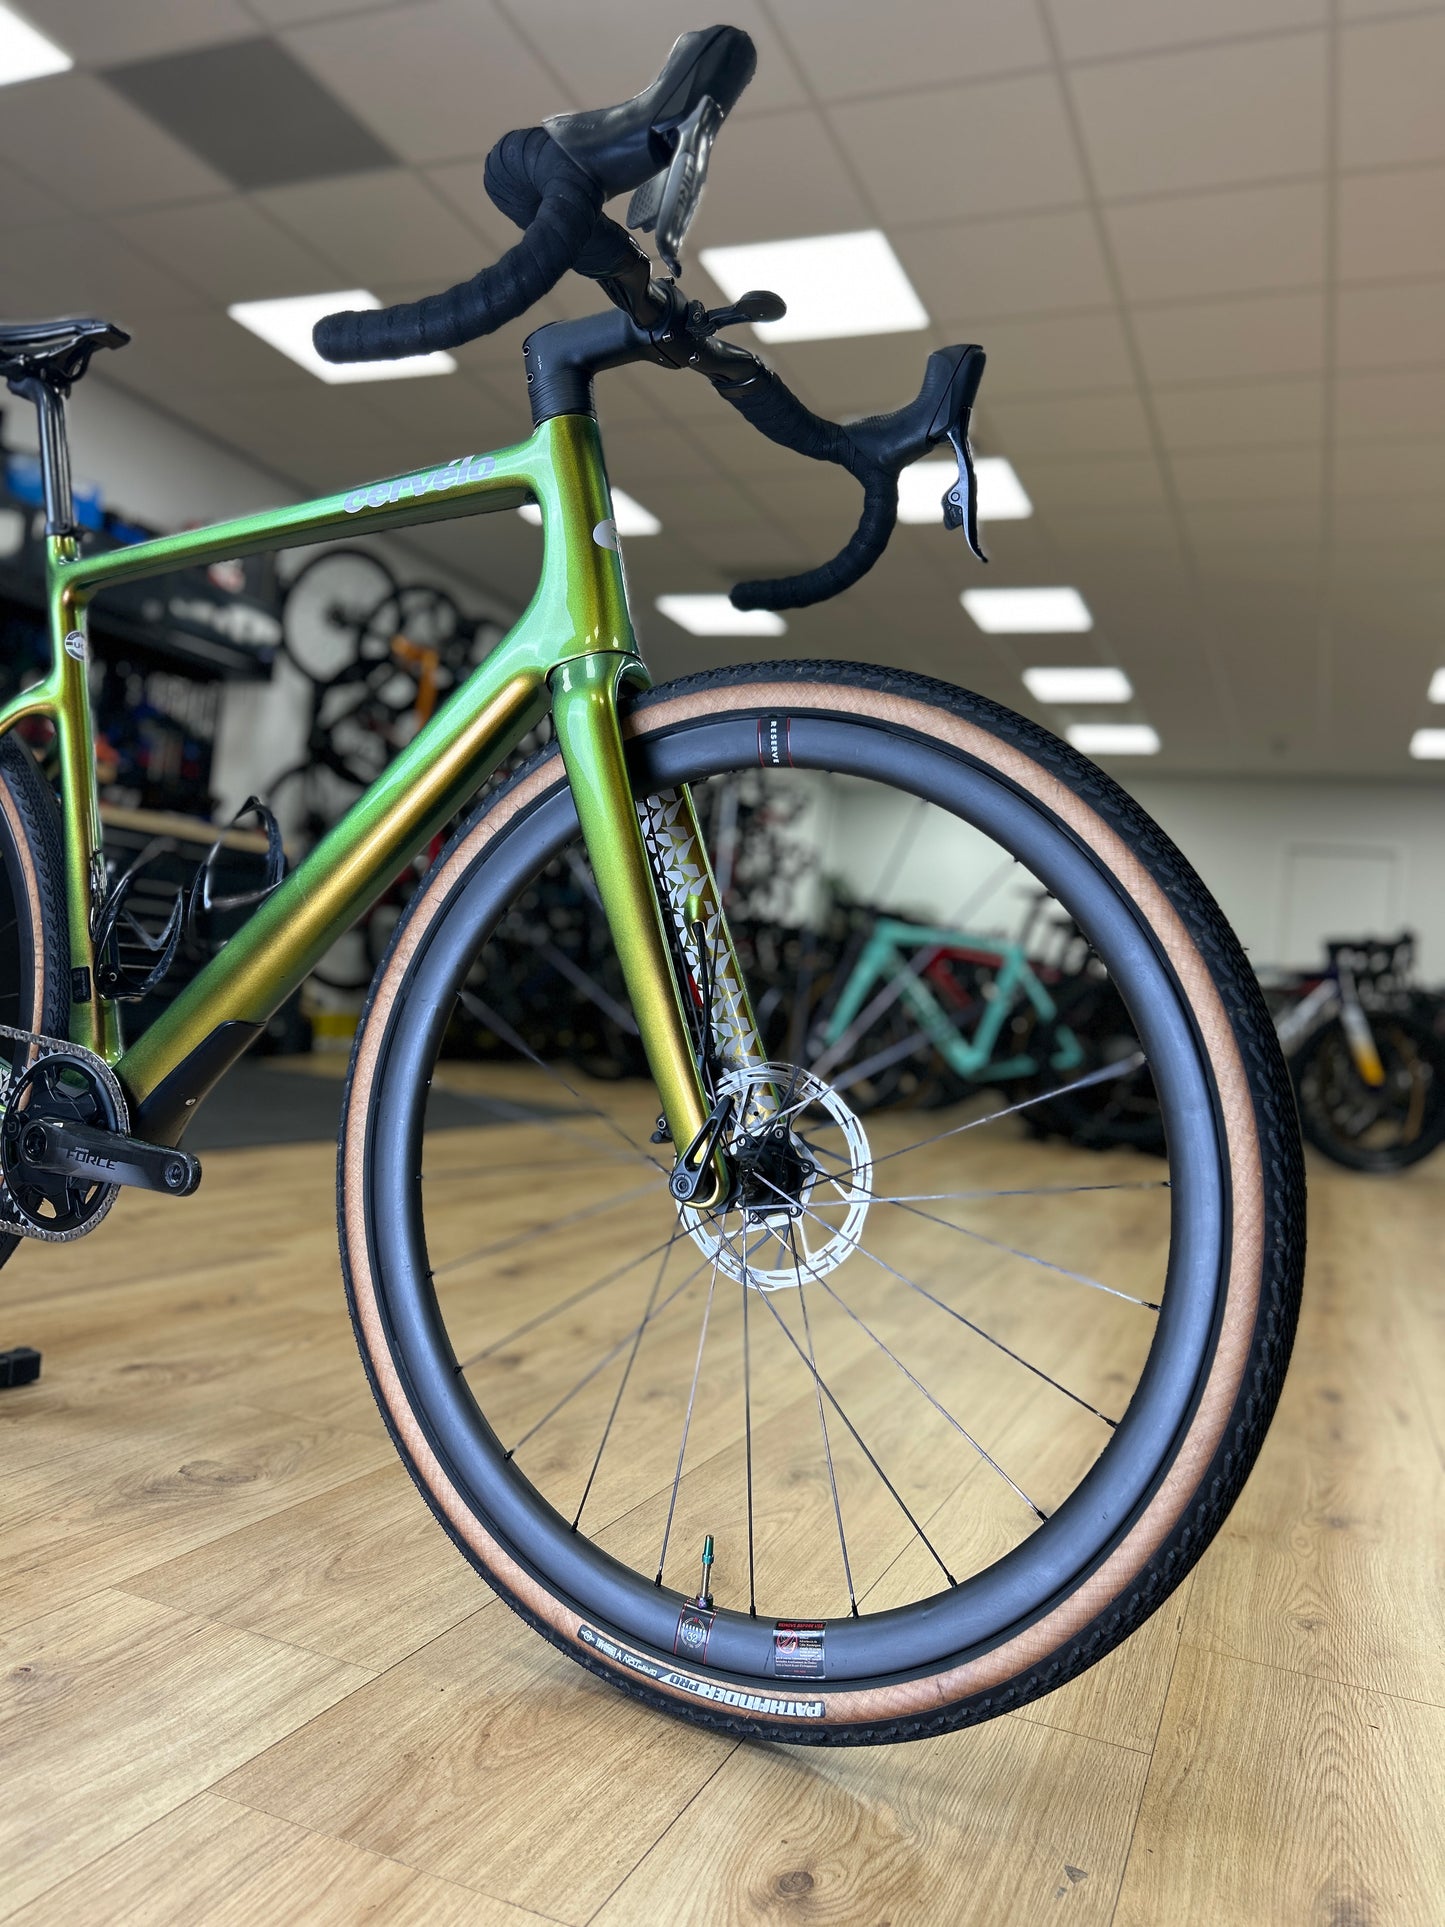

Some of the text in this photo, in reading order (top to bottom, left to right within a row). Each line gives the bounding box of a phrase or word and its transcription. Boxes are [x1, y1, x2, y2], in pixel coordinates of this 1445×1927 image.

[343, 455, 496, 513] cervélo
[770, 720, 779, 764] RESERVE
[66, 1150, 116, 1170] FORCE
[686, 1631, 698, 1643] 32
[669, 1674, 822, 1717] PATHFINDER PRO
